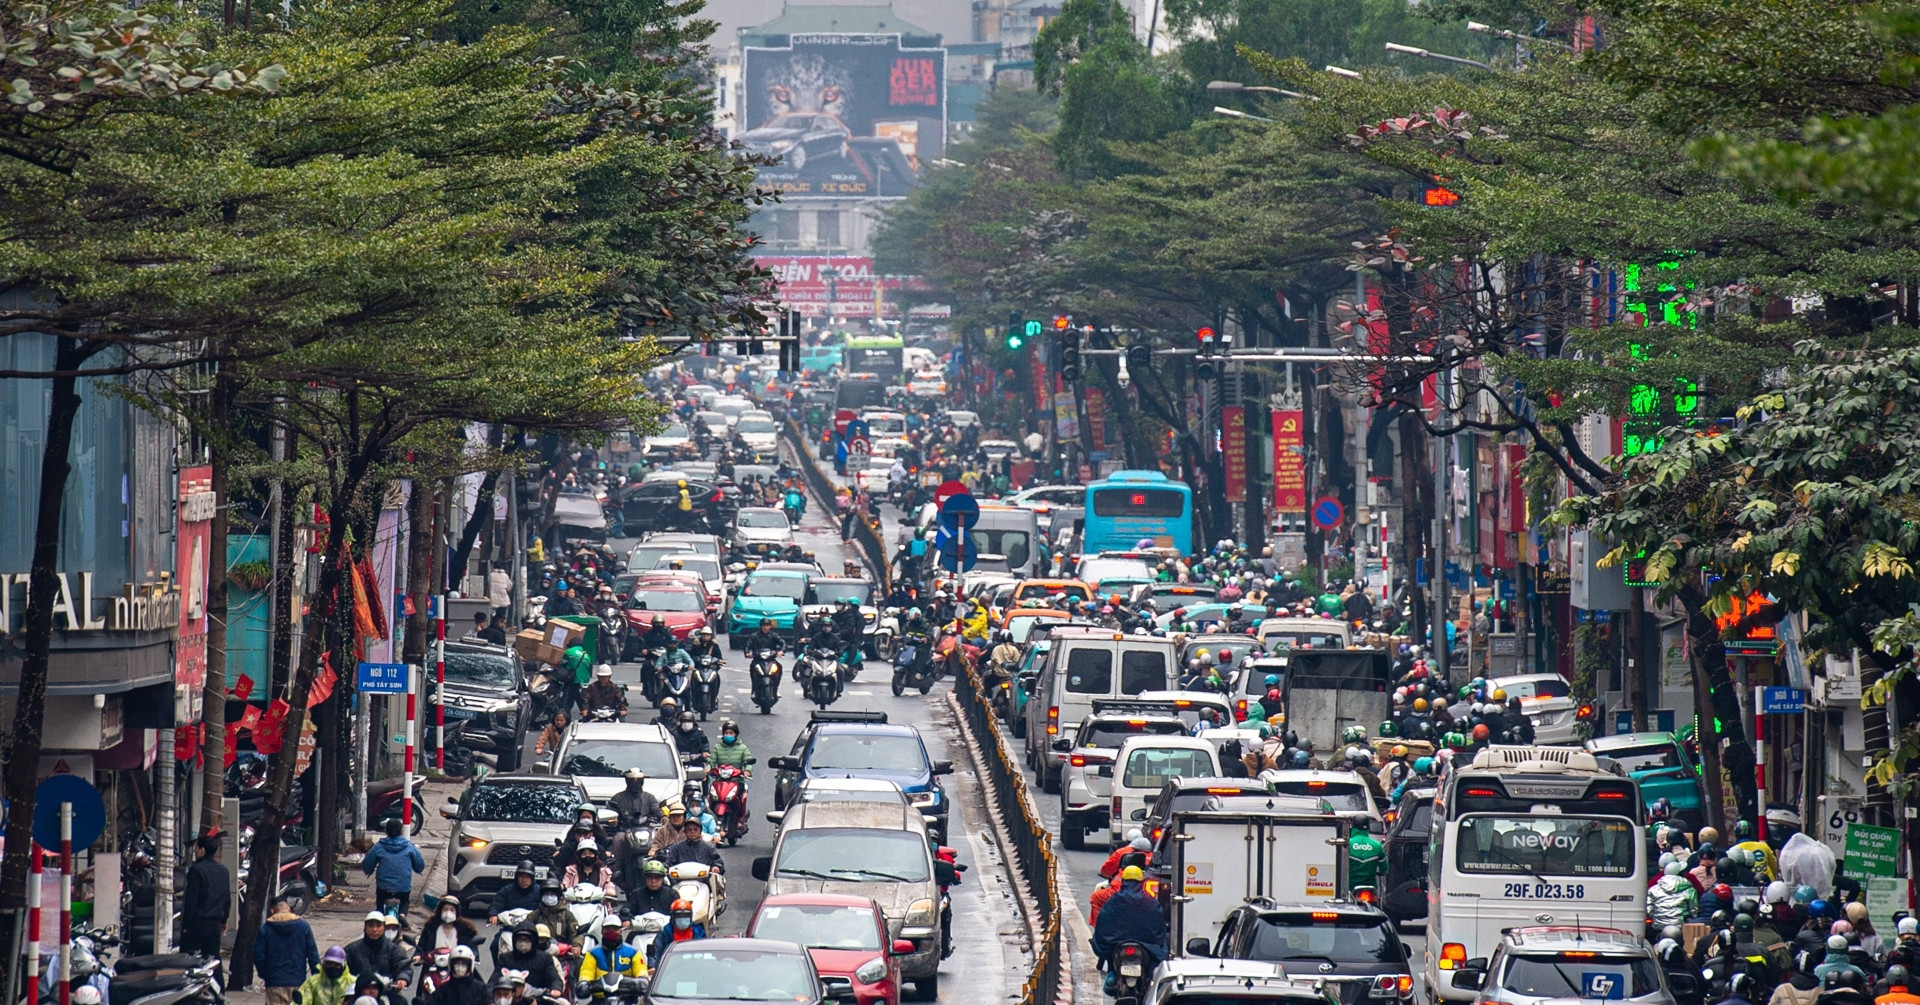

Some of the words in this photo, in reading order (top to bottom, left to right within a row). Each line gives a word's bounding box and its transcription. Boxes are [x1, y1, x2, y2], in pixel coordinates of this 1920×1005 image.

[387, 668, 398, 678] 112
[362, 680, 376, 688] PHỐ
[1353, 843, 1373, 851] Grab
